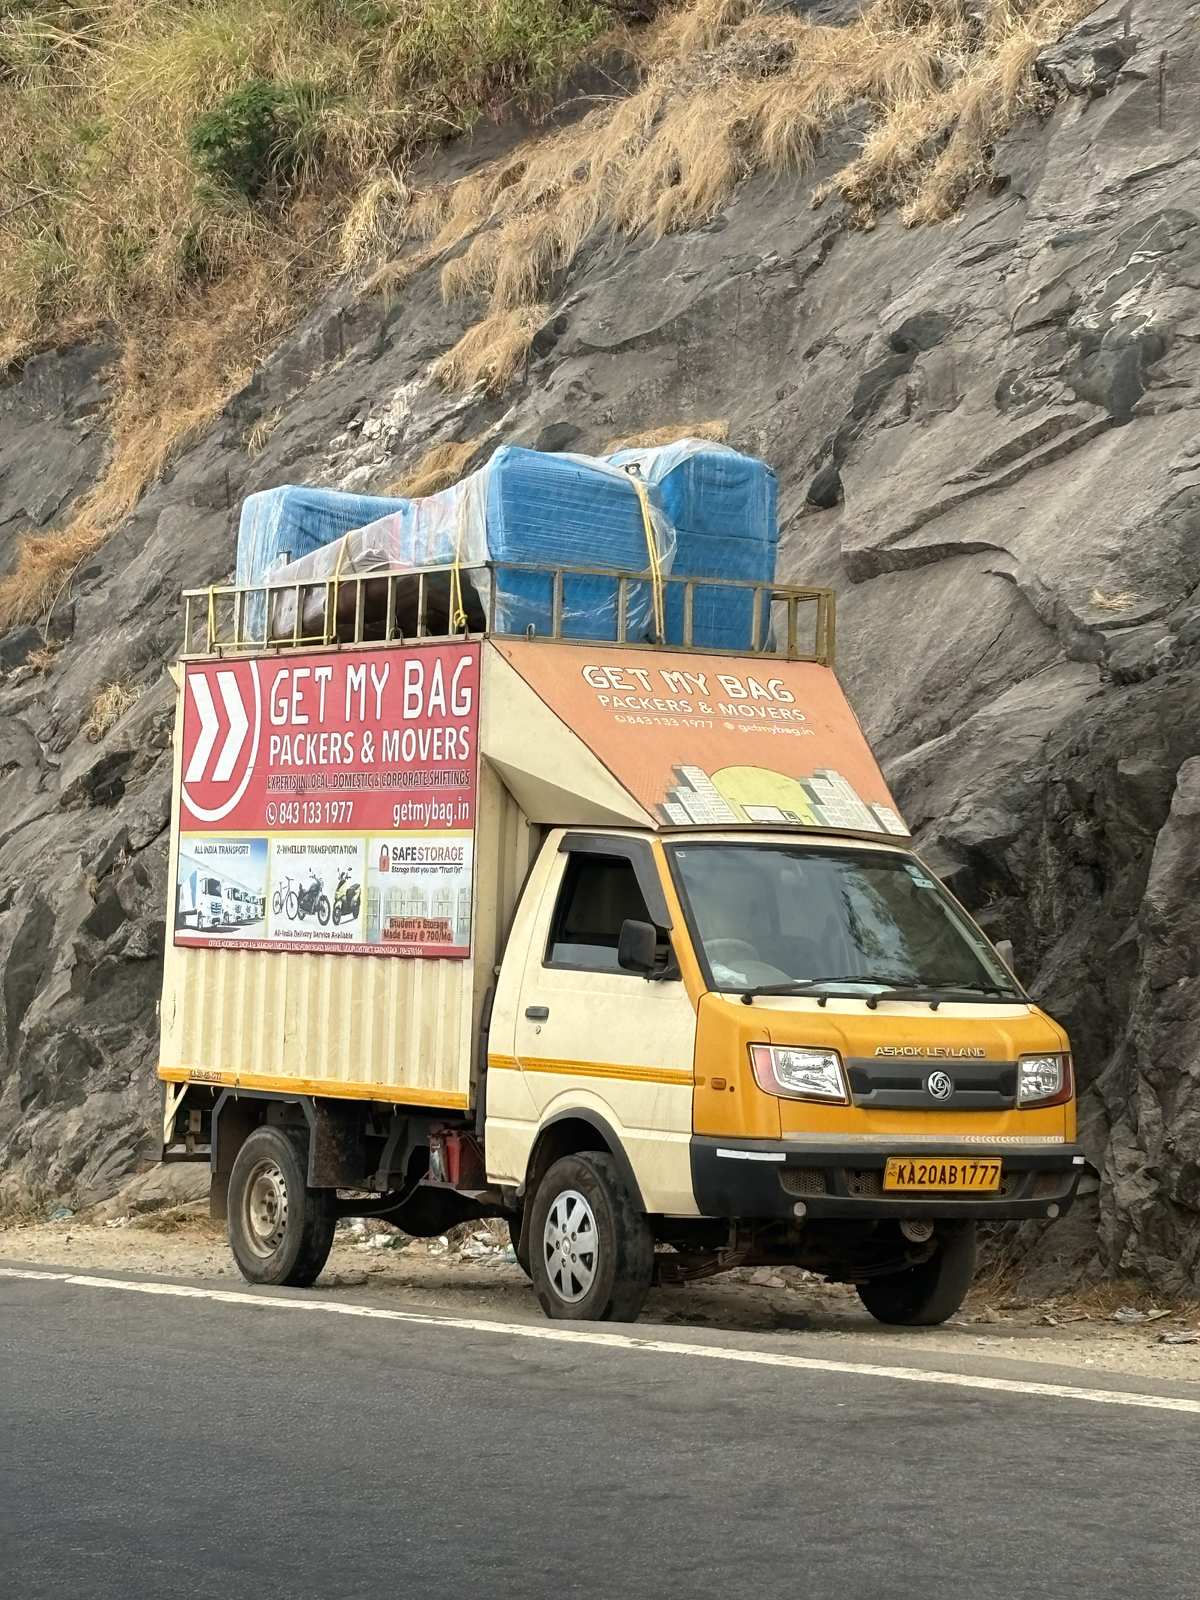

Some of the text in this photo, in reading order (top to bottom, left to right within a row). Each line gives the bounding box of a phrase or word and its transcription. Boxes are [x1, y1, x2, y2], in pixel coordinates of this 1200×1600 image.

[269, 656, 473, 726] GET MY BAG
[581, 665, 796, 703] GET MY BAG
[597, 694, 807, 721] PACKERS & MOVERS
[269, 726, 470, 766] PACKERS & MOVERS
[267, 775, 297, 789] EXPERTS
[333, 772, 374, 788] DOMESTIC
[381, 771, 428, 787] CORPORATE
[429, 769, 470, 786] SHIFTINGS
[280, 801, 353, 824] 843 133 1977
[393, 796, 469, 827] getmybag.in
[219, 844, 249, 855] TRANSPORT
[875, 1046, 986, 1058] ASHOK LEYLAND
[896, 1163, 999, 1185] KA20AB1777
